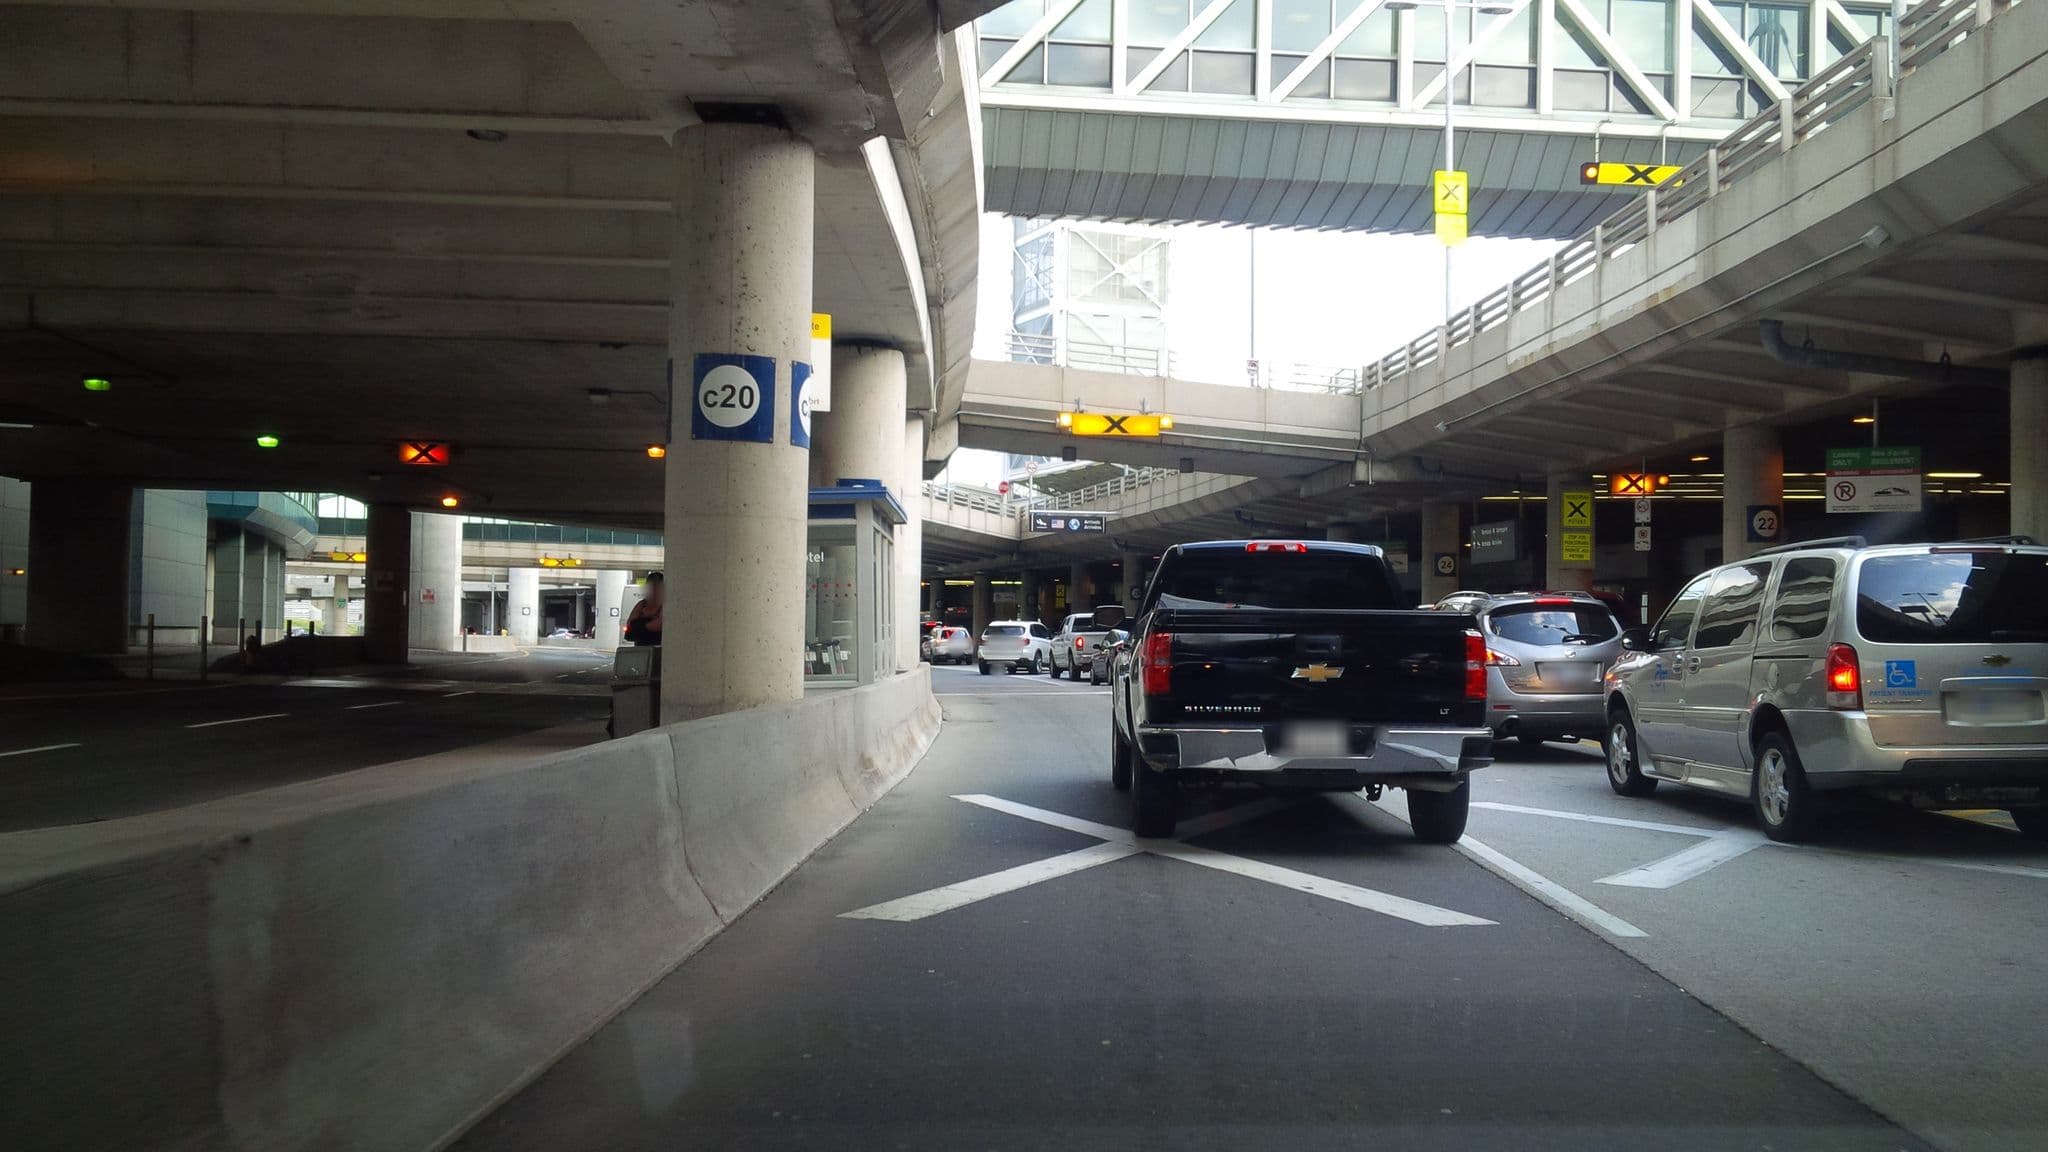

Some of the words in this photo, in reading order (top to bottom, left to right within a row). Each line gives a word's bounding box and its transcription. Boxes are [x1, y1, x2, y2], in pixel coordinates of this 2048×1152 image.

[703, 384, 755, 409] c20
[1758, 517, 1775, 529] 22
[1440, 560, 1453, 570] 24
[1184, 705, 1262, 713] SILVERADO
